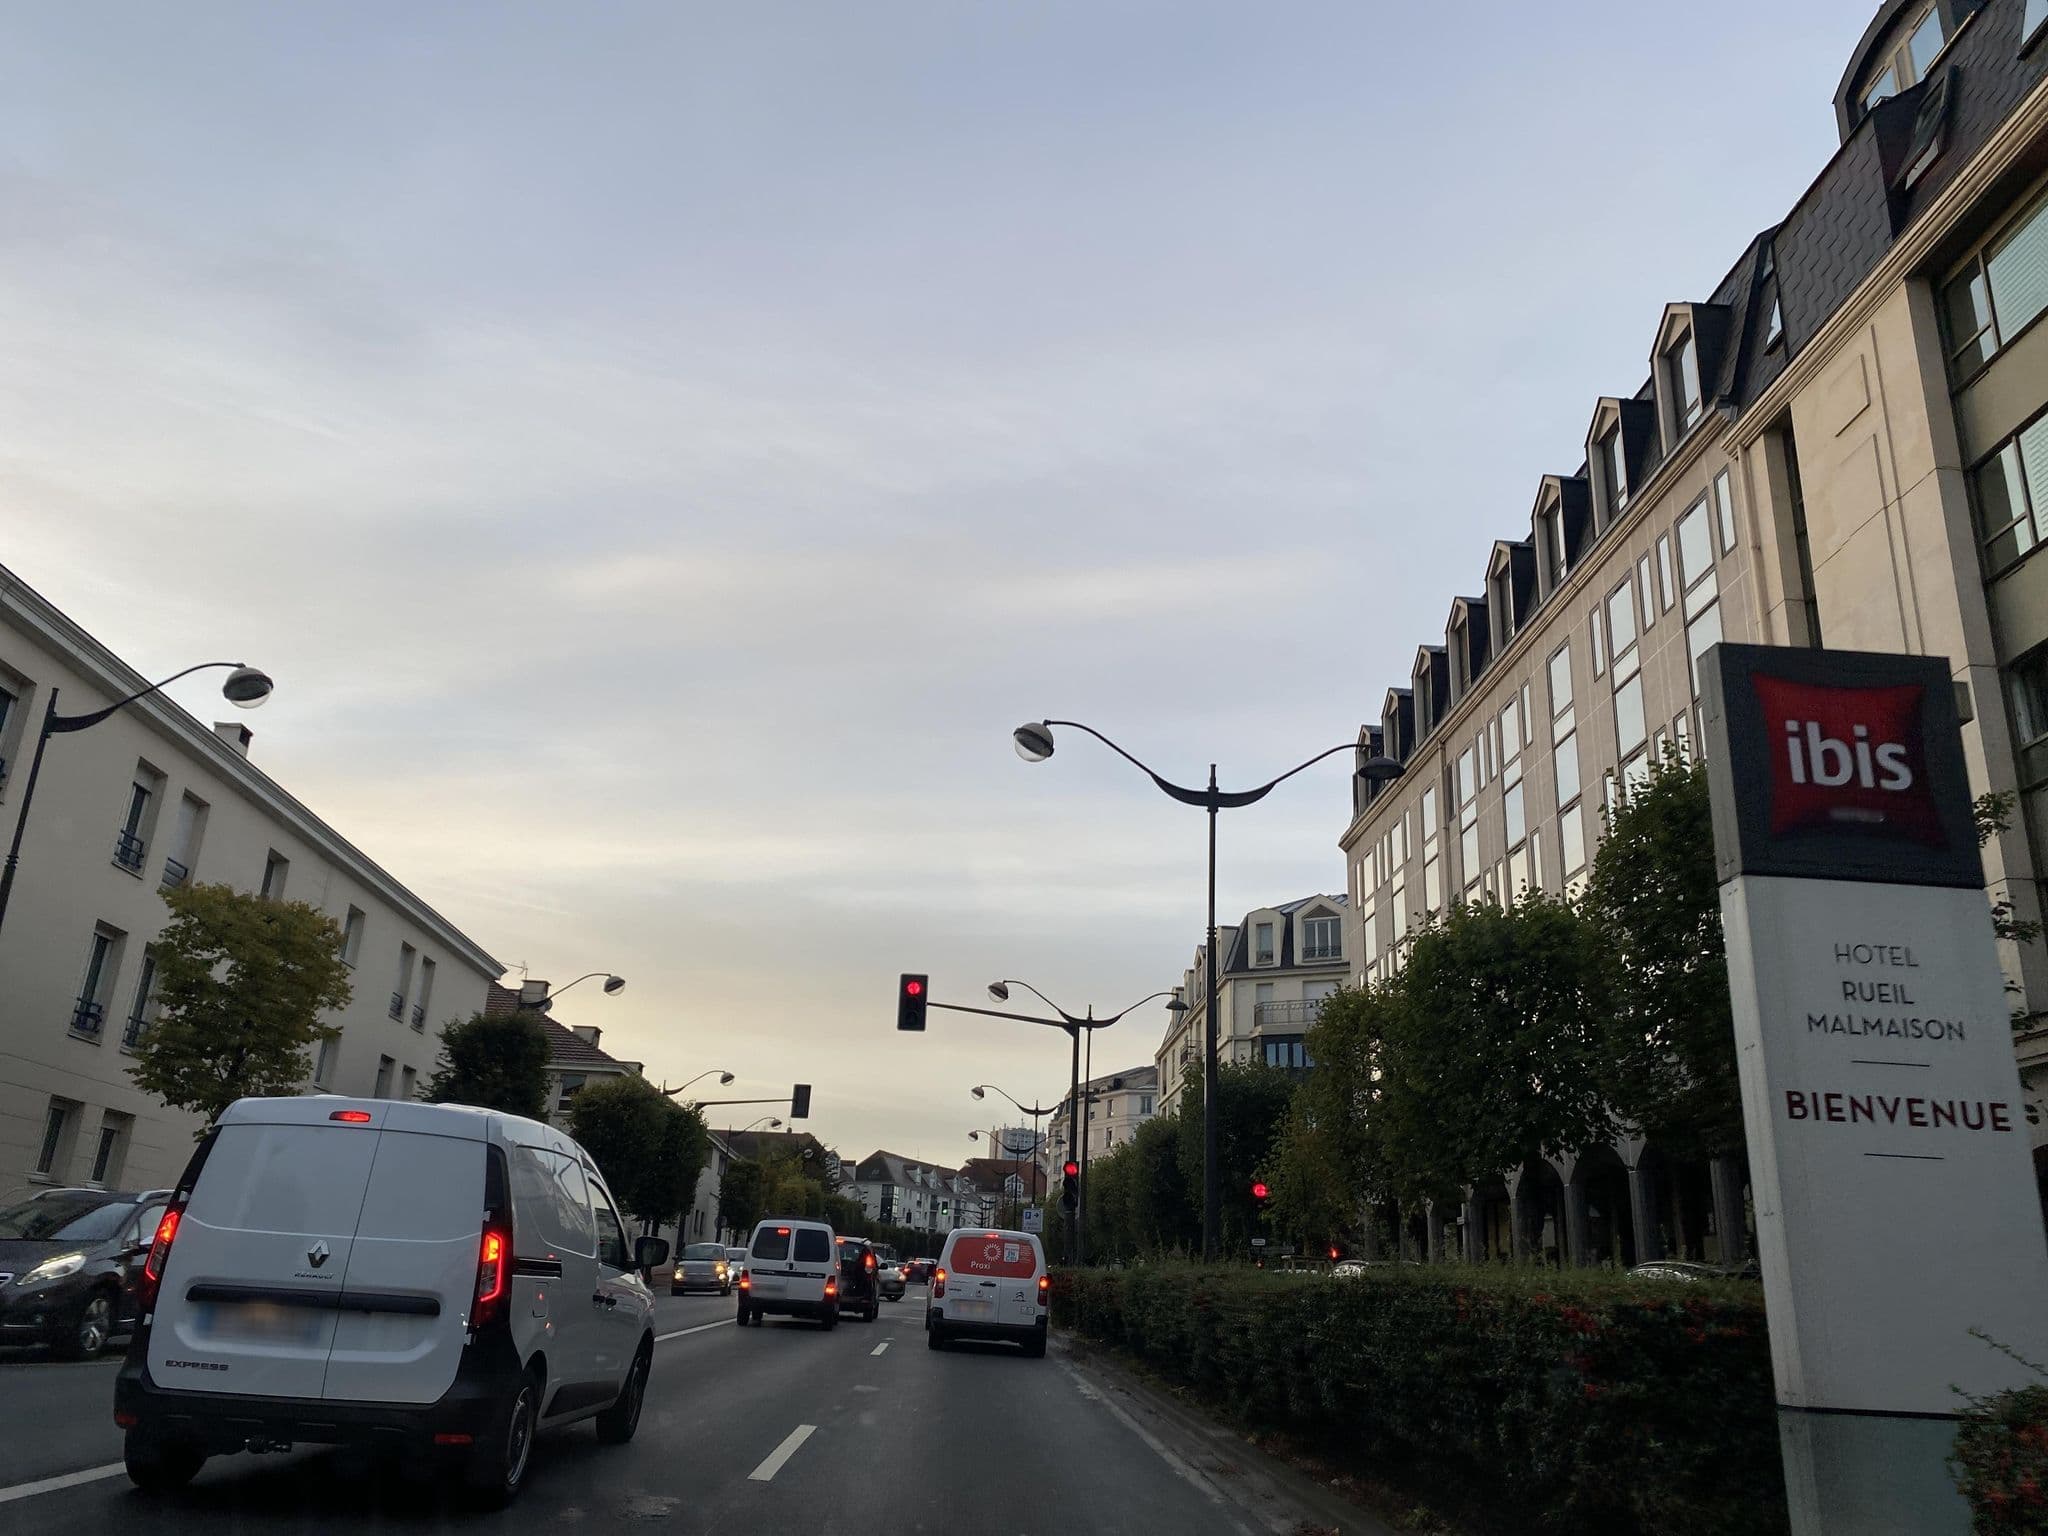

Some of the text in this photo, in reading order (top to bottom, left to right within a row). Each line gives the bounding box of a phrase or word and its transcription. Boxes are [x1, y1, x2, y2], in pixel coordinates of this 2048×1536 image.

[1785, 719, 1913, 791] ibis
[1834, 943, 1919, 968] HOTEL
[1842, 981, 1915, 1005] RUEIL
[1807, 1013, 1966, 1041] MALMAISON
[1786, 1090, 2012, 1132] BIENVENUE
[165, 1360, 229, 1371] EXPRESS
